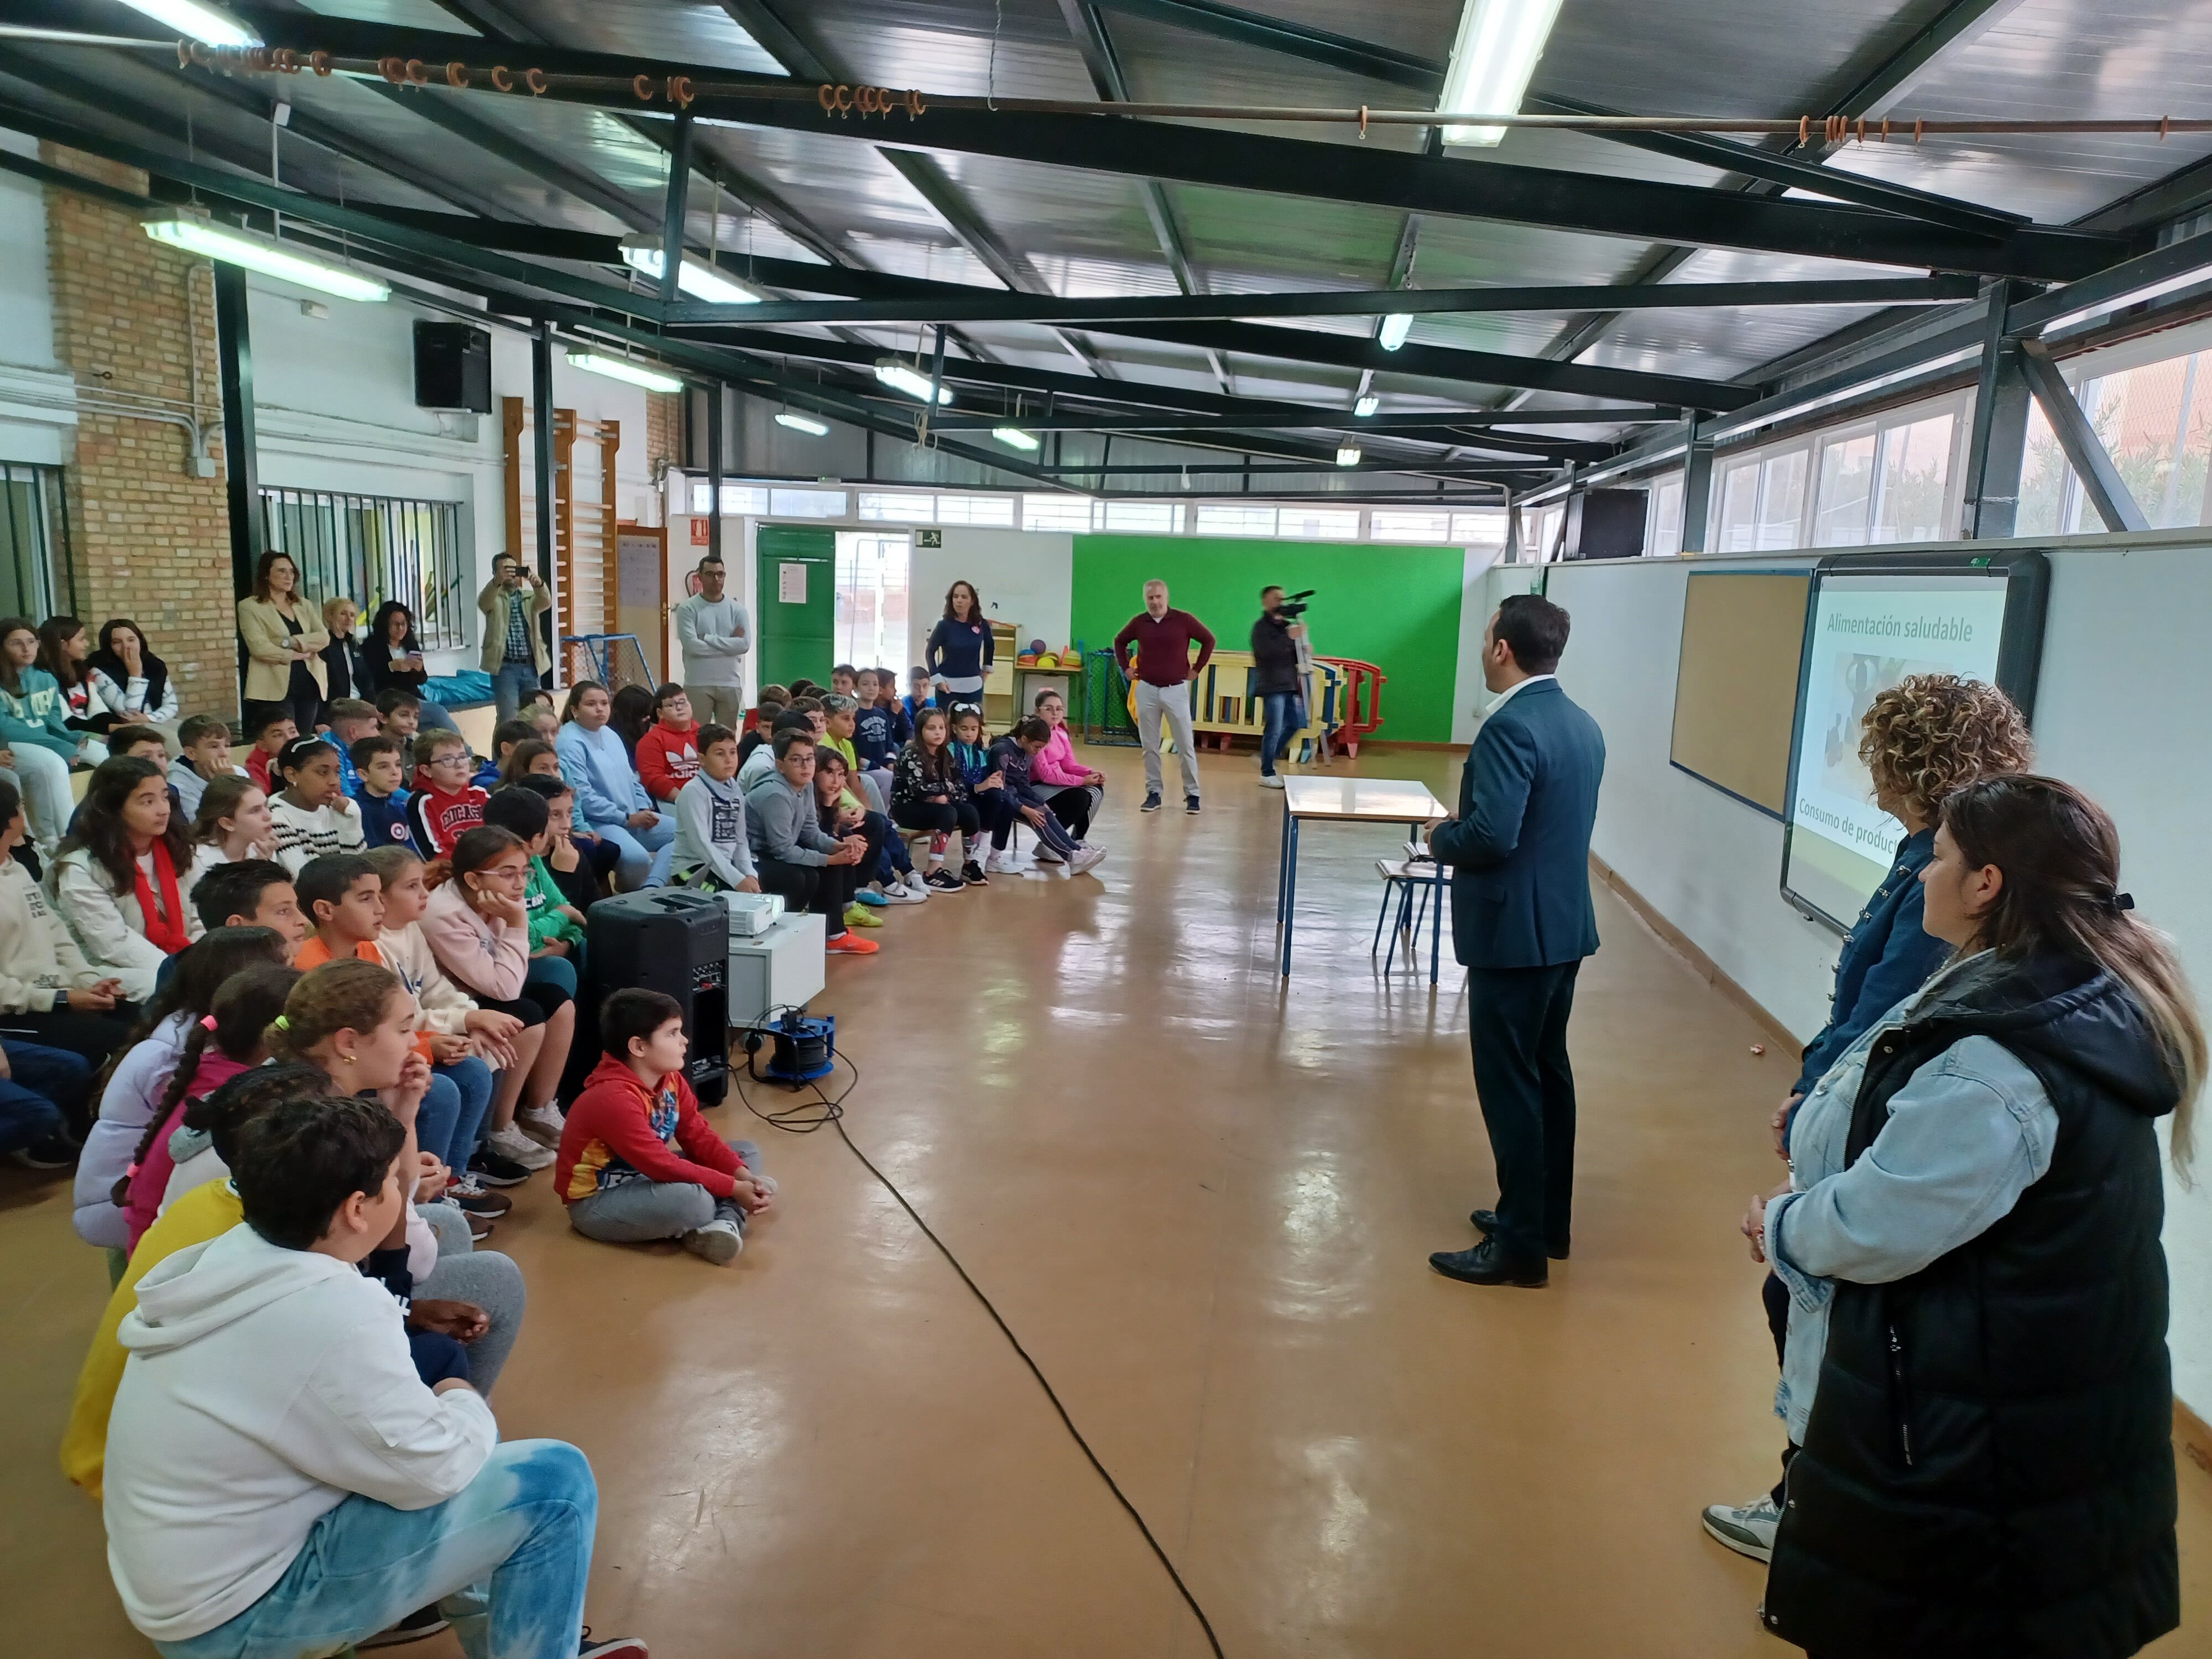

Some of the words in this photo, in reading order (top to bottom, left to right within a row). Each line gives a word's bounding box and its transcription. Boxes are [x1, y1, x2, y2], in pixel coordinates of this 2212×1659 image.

[1827, 612, 1901, 637] Alimentación
[1904, 615, 1973, 642] saludable
[441, 804, 483, 831] CHICAG
[1799, 798, 1839, 828] Consumo
[1842, 816, 1854, 836] de
[1856, 826, 1897, 854] product
